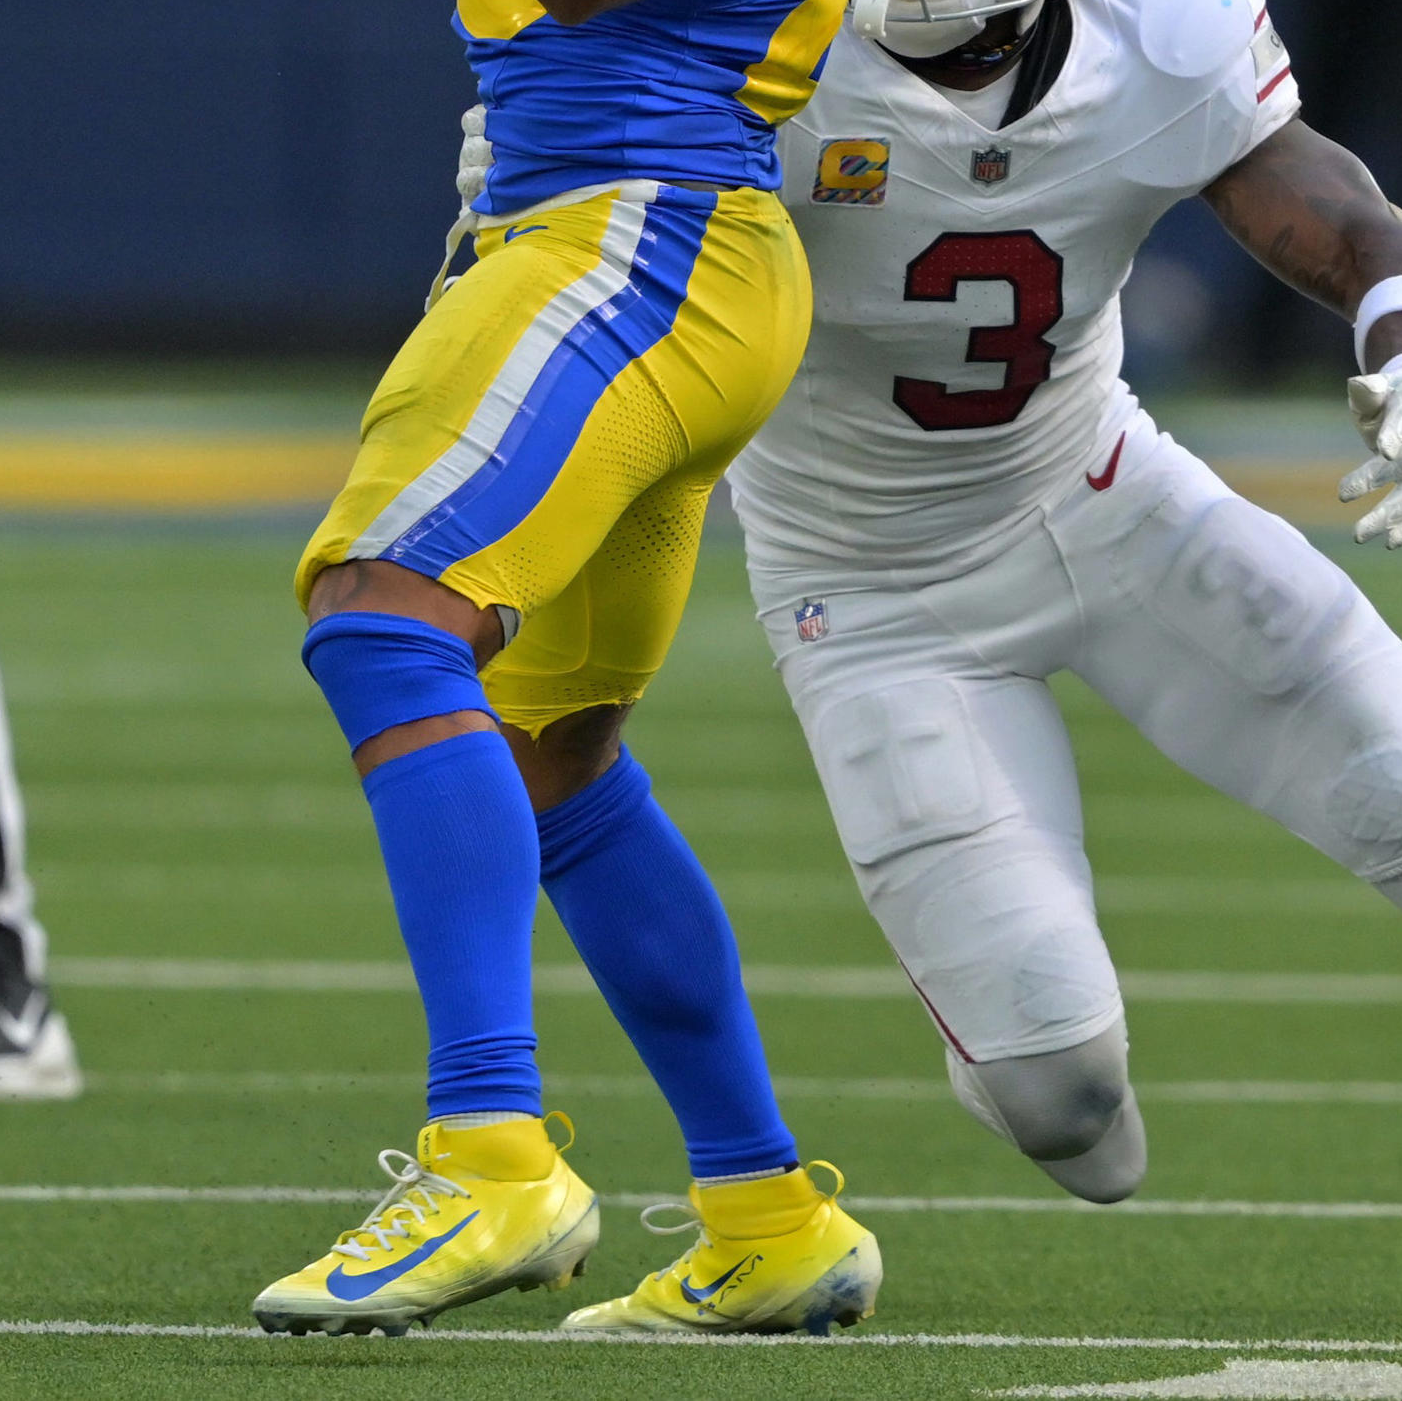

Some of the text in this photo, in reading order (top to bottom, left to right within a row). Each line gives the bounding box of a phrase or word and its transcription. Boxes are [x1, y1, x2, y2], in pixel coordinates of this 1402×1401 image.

[820, 141, 888, 189] C
[976, 163, 1006, 179] NFL
[892, 229, 1064, 431] 3
[800, 616, 823, 638] NFL
